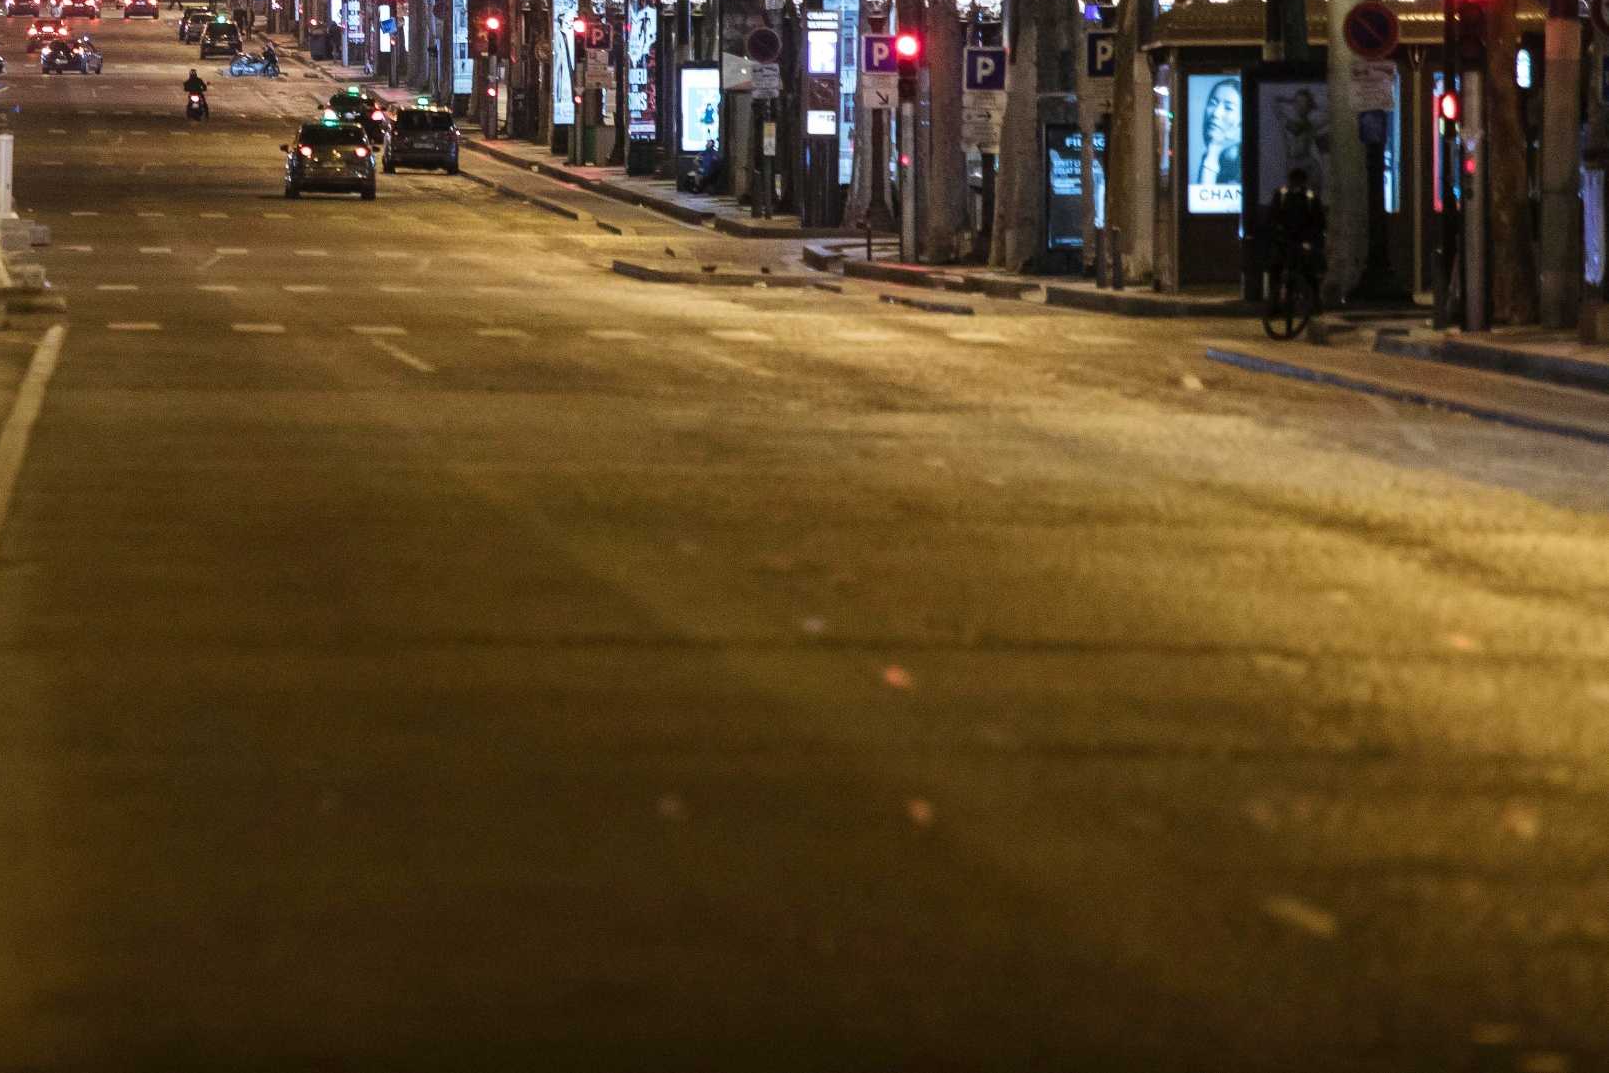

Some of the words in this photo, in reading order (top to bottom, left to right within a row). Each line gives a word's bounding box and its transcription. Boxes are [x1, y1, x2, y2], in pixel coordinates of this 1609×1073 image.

[592, 29, 604, 46] P
[873, 42, 889, 67] P
[1096, 40, 1112, 70] P
[976, 56, 995, 83] P
